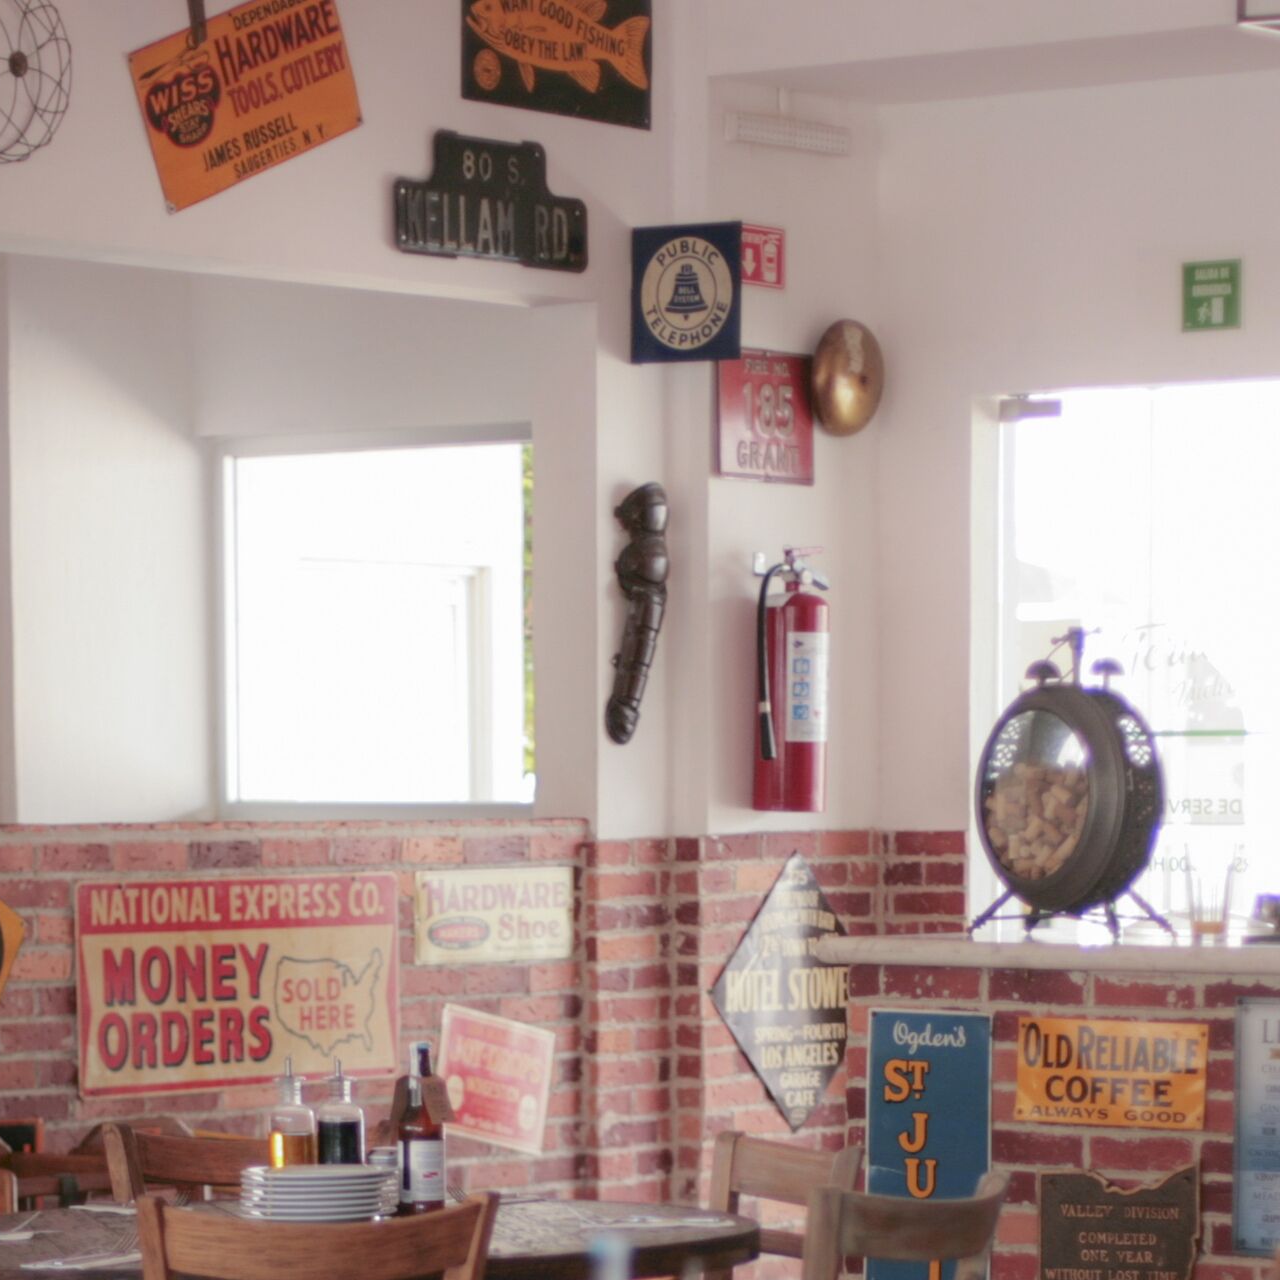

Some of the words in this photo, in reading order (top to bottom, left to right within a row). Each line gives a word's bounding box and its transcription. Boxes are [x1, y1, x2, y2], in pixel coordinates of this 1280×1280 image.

[214, 2, 339, 87] HARDWARE
[503, 28, 535, 54] OBEY
[538, 38, 559, 60] THE
[539, 0, 573, 29] GOOD
[576, 18, 626, 57] FISHING
[280, 42, 346, 91] CUTLERY
[150, 69, 214, 116] WISS
[204, 140, 242, 172] JAMES
[243, 113, 298, 150] RUSSELL
[462, 150, 492, 181] 80
[406, 189, 515, 256] KELLAM
[656, 239, 719, 267] PUBLIC
[646, 301, 728, 346] TELEPHONE
[744, 358, 769, 375] FIRE
[741, 380, 795, 439] 185
[736, 439, 801, 473] GRANT
[90, 886, 221, 926] NATIONAL
[229, 883, 341, 922] EXPRESS
[348, 882, 385, 917] CO.
[426, 879, 569, 919] HARDWARE
[497, 912, 560, 942] Shoe
[101, 943, 270, 1007] MONEY
[281, 978, 341, 1004] SOLD
[725, 969, 783, 1013] HOTEL
[299, 1004, 356, 1032] HERE
[98, 1005, 274, 1071] ORDERS
[892, 1020, 966, 1054] Ogden's
[1022, 1022, 1073, 1070] OLD
[1076, 1025, 1199, 1075] RELIABLE
[761, 1045, 783, 1069] LOS
[784, 1042, 839, 1068] ANGELES
[779, 1071, 821, 1090] GARAGE
[1044, 1075, 1173, 1108] COFFEE
[785, 1089, 815, 1108] CAFE
[1029, 1104, 1109, 1120] ALWAYS
[1123, 1108, 1187, 1124] GOOD
[1060, 1204, 1112, 1218] VALLEY
[1124, 1206, 1180, 1220] DIVISION
[1078, 1231, 1157, 1246] COMPLETED
[1080, 1249, 1108, 1263] ONE
[1119, 1250, 1153, 1265] YEAR
